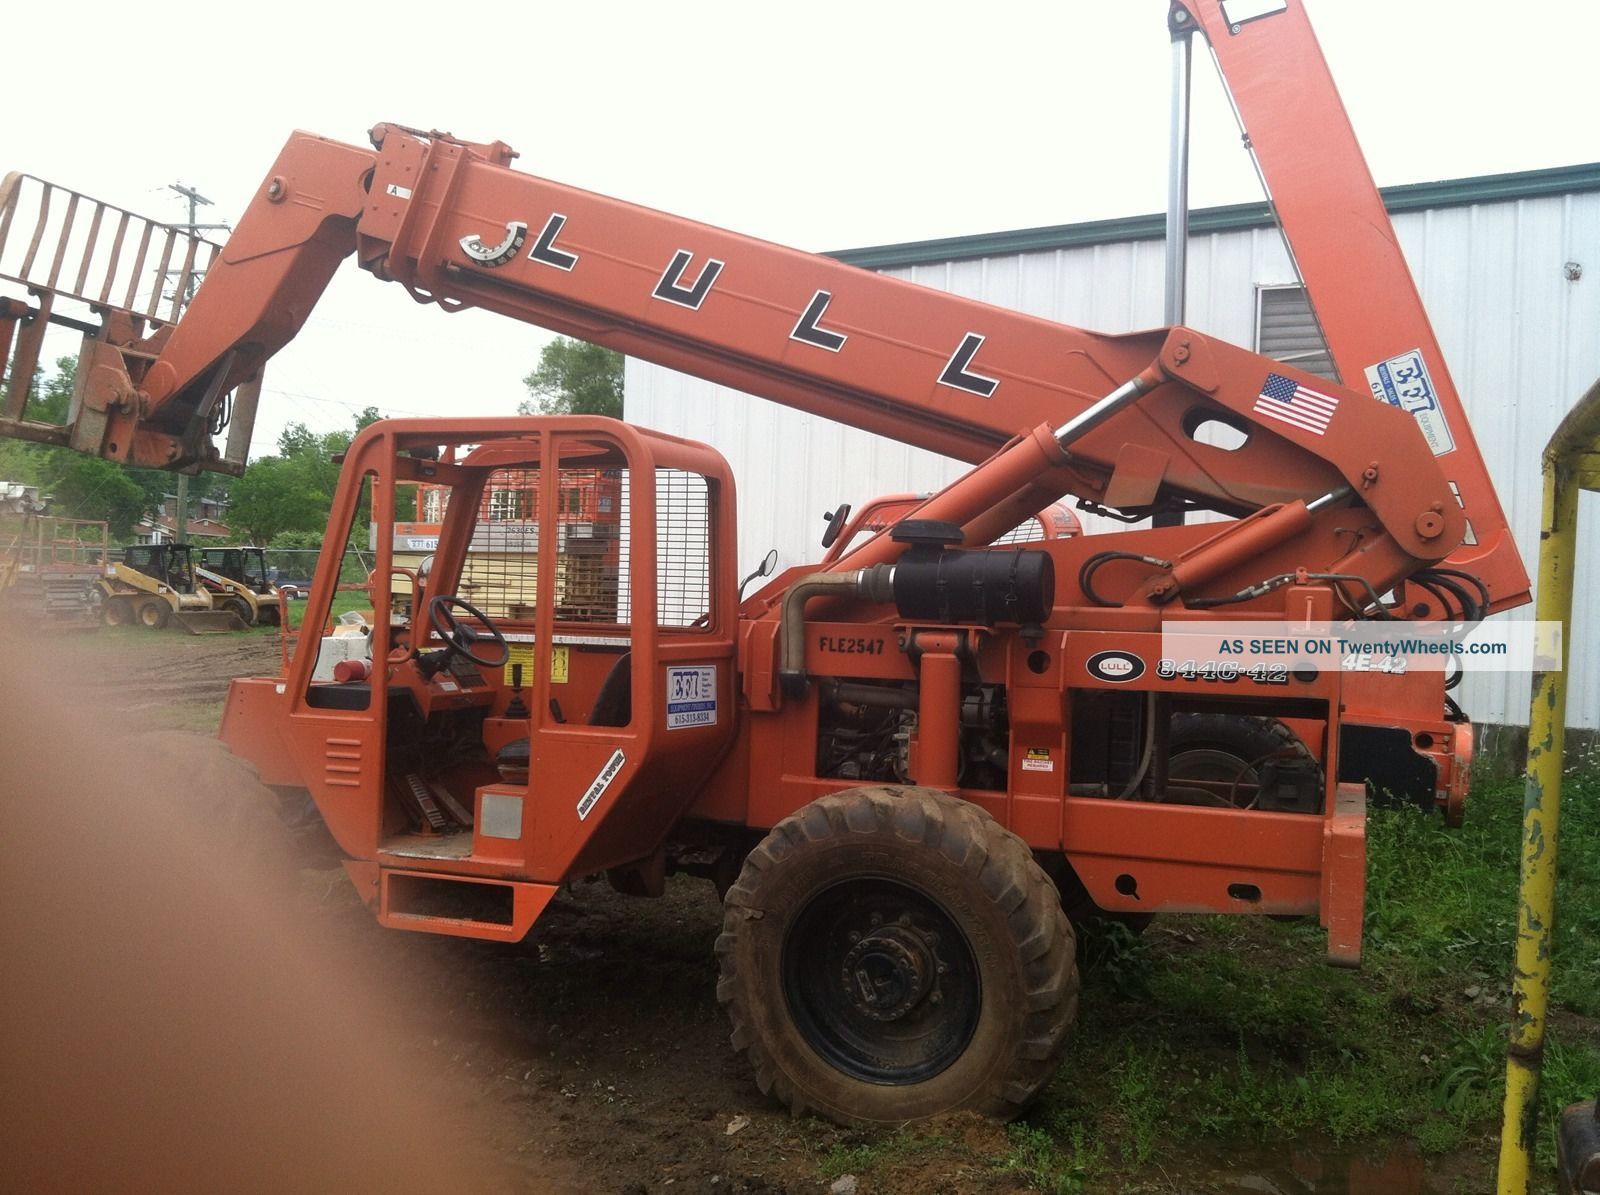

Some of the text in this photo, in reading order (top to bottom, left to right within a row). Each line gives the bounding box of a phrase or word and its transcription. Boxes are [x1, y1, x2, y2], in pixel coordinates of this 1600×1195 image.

[528, 213, 1000, 398] LULL
[1420, 413, 1439, 447] EQUIPMENT
[818, 636, 885, 655] FLE2547
[1100, 662, 1131, 671] LULL
